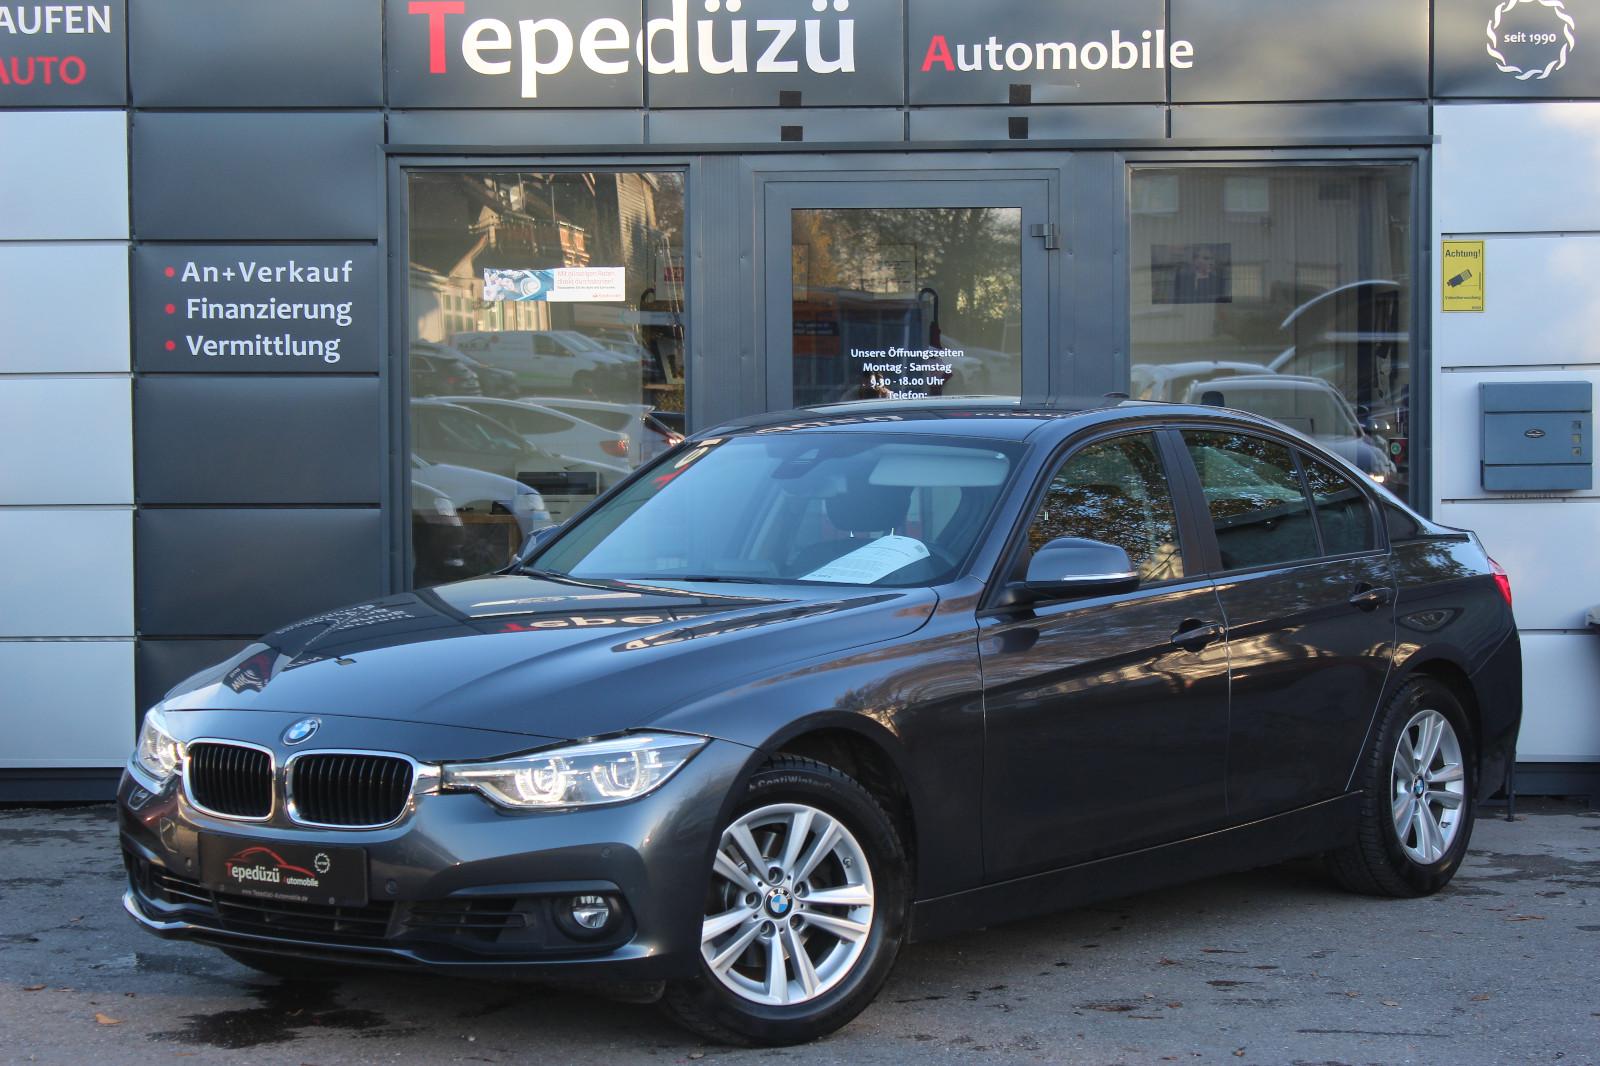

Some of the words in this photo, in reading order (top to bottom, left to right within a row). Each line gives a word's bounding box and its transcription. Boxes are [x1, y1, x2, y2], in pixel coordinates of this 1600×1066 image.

[0, 6, 111, 34] AUFEN
[1504, 32, 1526, 42] seit
[1529, 33, 1556, 44] 1990
[408, 0, 855, 98] Tepedüzü
[920, 30, 1194, 71] Automobile
[1445, 249, 1481, 259] Achtung!
[181, 260, 353, 283] An+Verkauf
[186, 297, 353, 326] Finanzierung
[186, 334, 341, 363] Vermittlung
[850, 348, 886, 358] Unsere
[888, 347, 964, 359] Öffnungszeiten
[863, 362, 902, 374] Montag
[909, 362, 953, 373] Samstag
[899, 377, 924, 386] 18.00
[926, 376, 945, 386] Uhr
[889, 390, 928, 399] Telefon:
[225, 862, 280, 882] Tepedüzü
